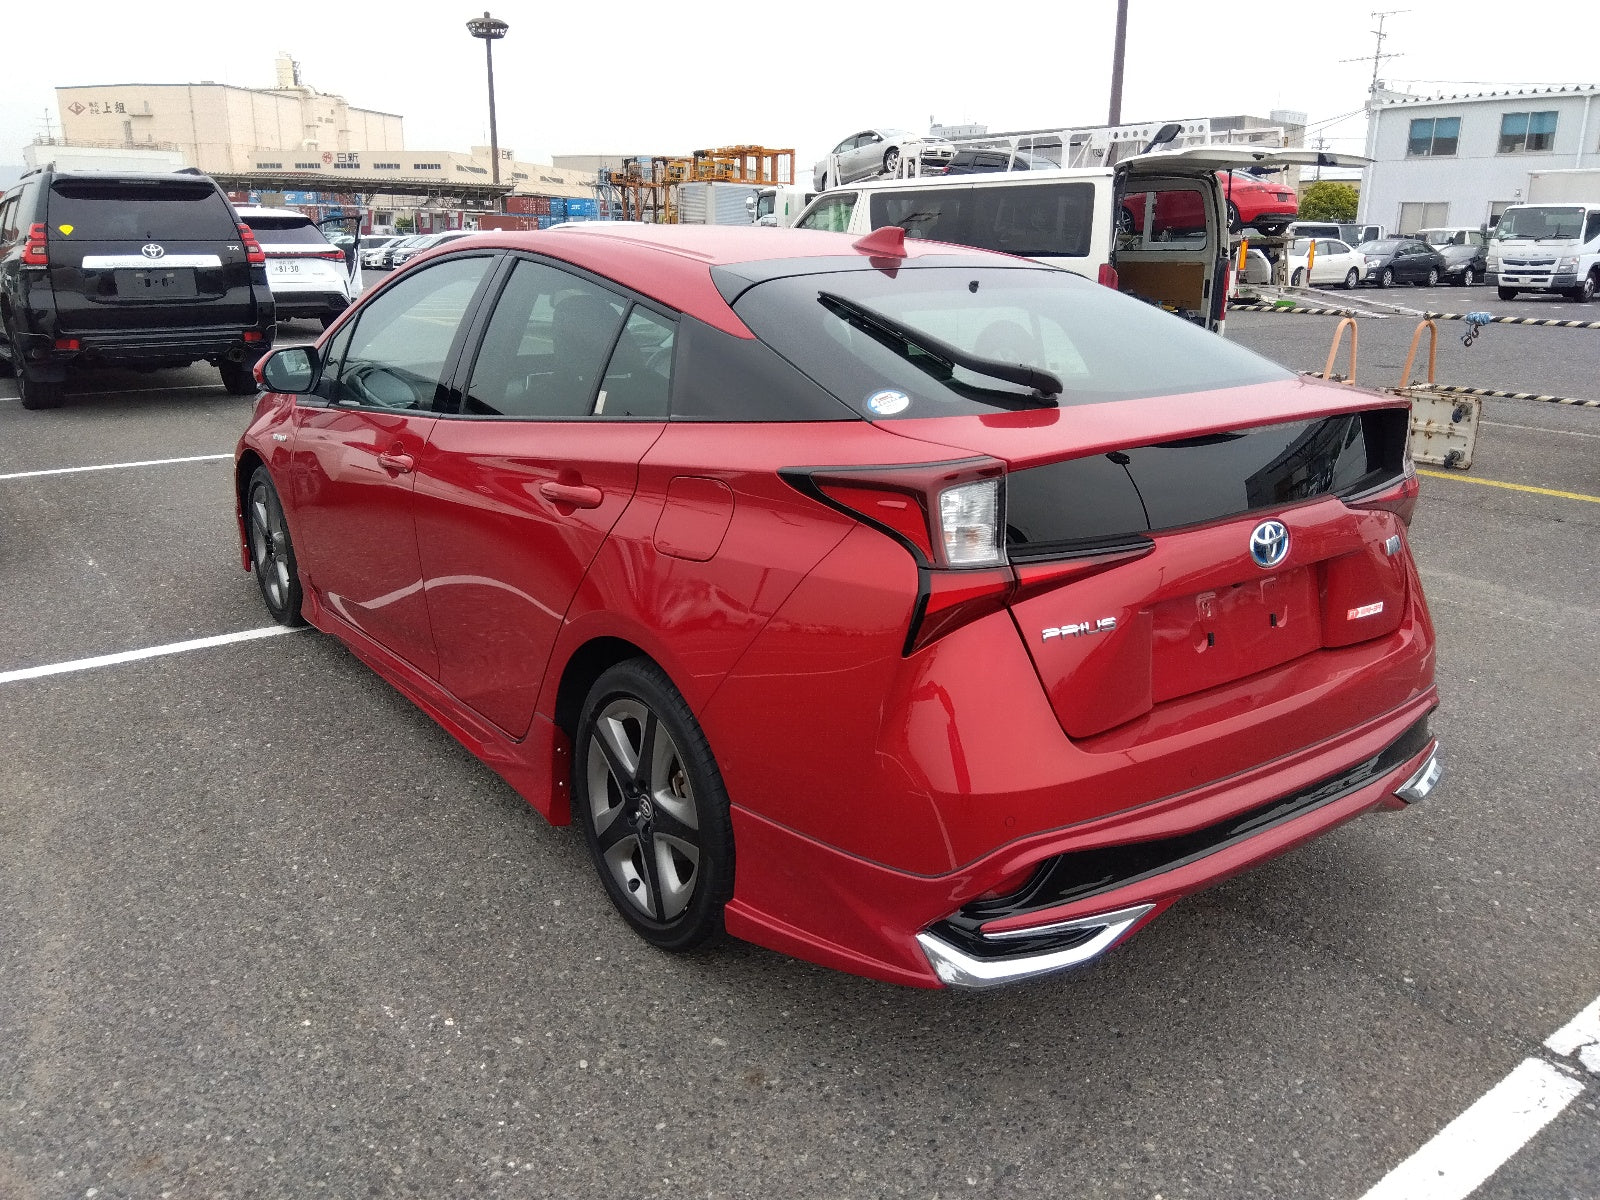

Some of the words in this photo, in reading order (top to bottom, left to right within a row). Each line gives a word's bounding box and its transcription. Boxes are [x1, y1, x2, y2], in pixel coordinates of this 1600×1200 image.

[103, 101, 127, 114] 上組
[337, 152, 359, 163] 日新
[1041, 616, 1117, 644] PRIUS
